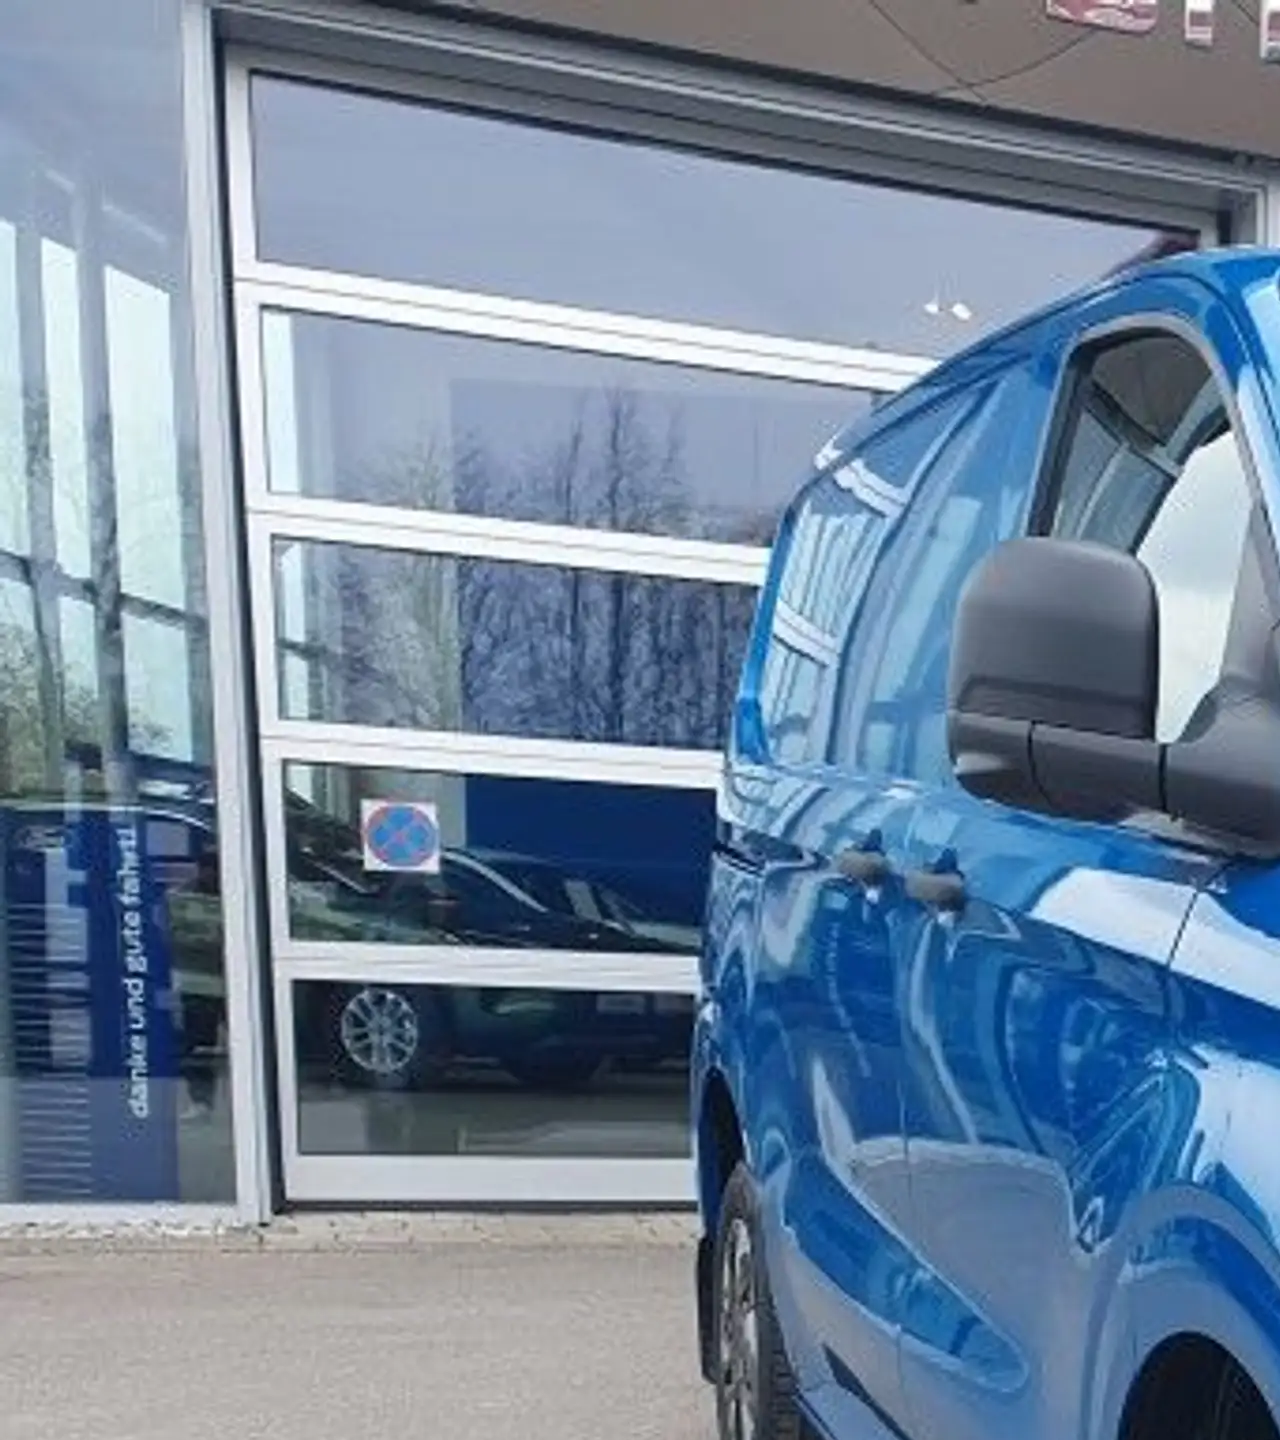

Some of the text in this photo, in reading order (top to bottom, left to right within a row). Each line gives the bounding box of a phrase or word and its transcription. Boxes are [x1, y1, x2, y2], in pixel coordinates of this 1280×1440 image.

[121, 910, 148, 973] gute
[122, 978, 146, 1029] und
[126, 1034, 149, 1118] danke
